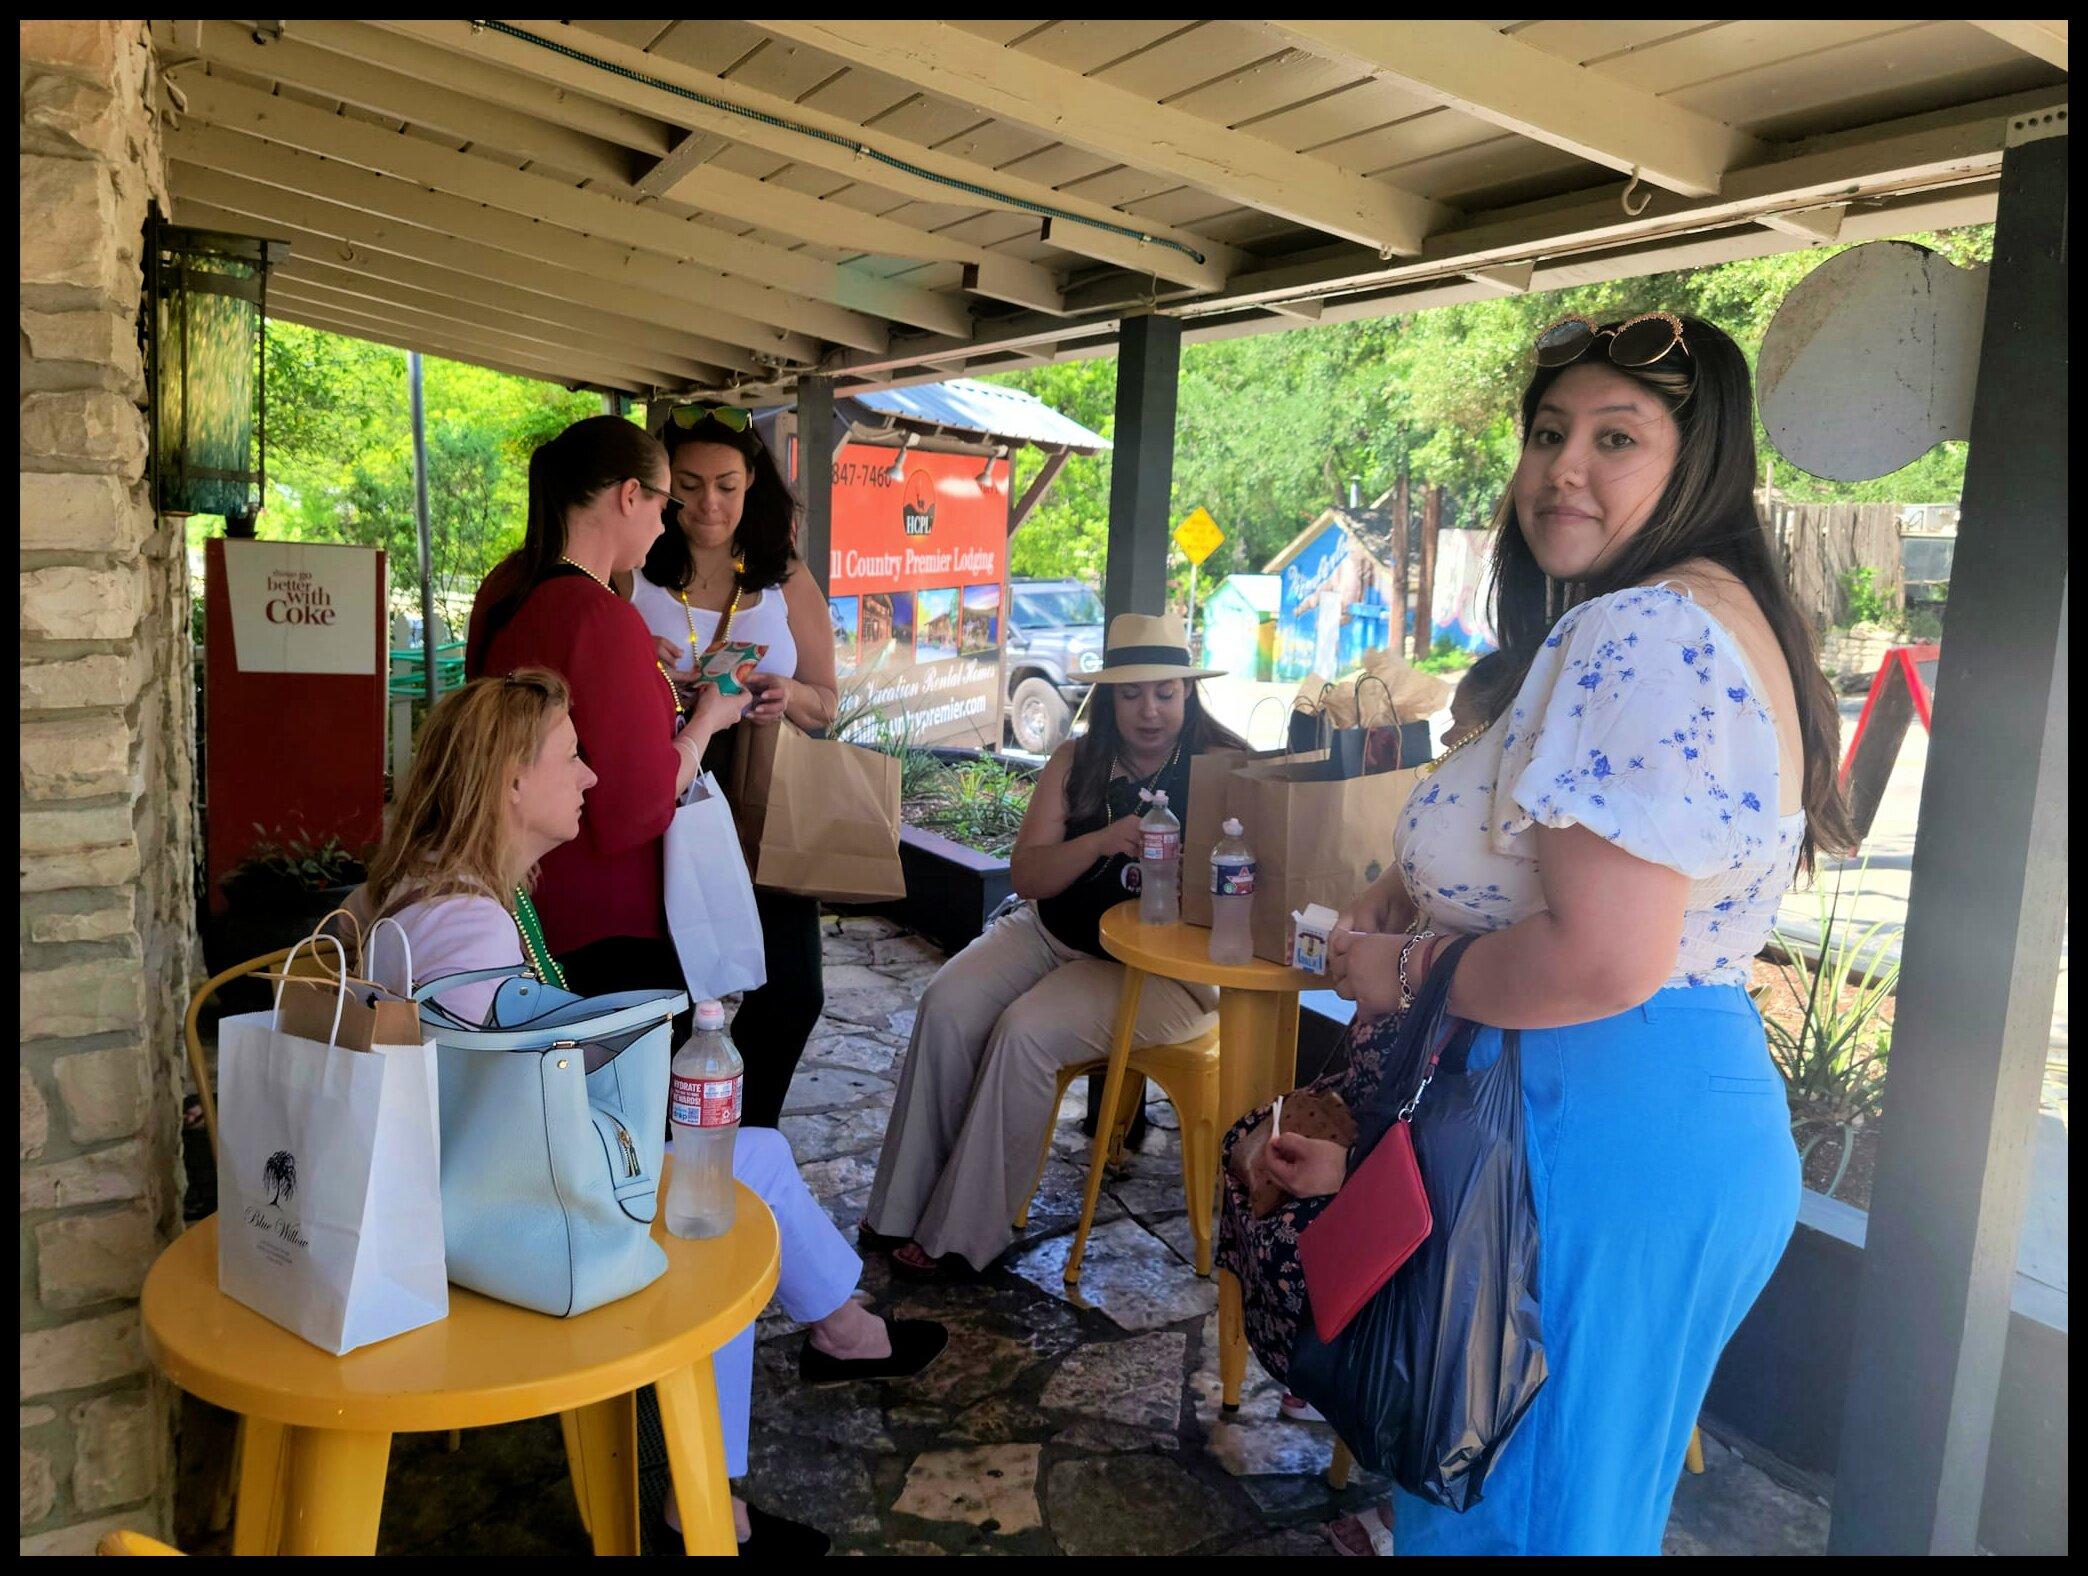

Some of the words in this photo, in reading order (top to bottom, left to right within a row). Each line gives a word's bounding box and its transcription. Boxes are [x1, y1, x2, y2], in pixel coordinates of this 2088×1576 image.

[906, 515, 932, 534] HCPL
[846, 550, 902, 581] Country
[905, 548, 952, 575] Premier
[954, 546, 995, 576] Lodging
[267, 576, 312, 591] better
[286, 587, 331, 605] with
[265, 599, 336, 625] Coke
[867, 675, 919, 705] Vacation
[922, 663, 961, 694] Rental
[962, 658, 995, 683] Homes
[243, 1206, 272, 1230] Blue
[275, 1218, 310, 1247] Willow
